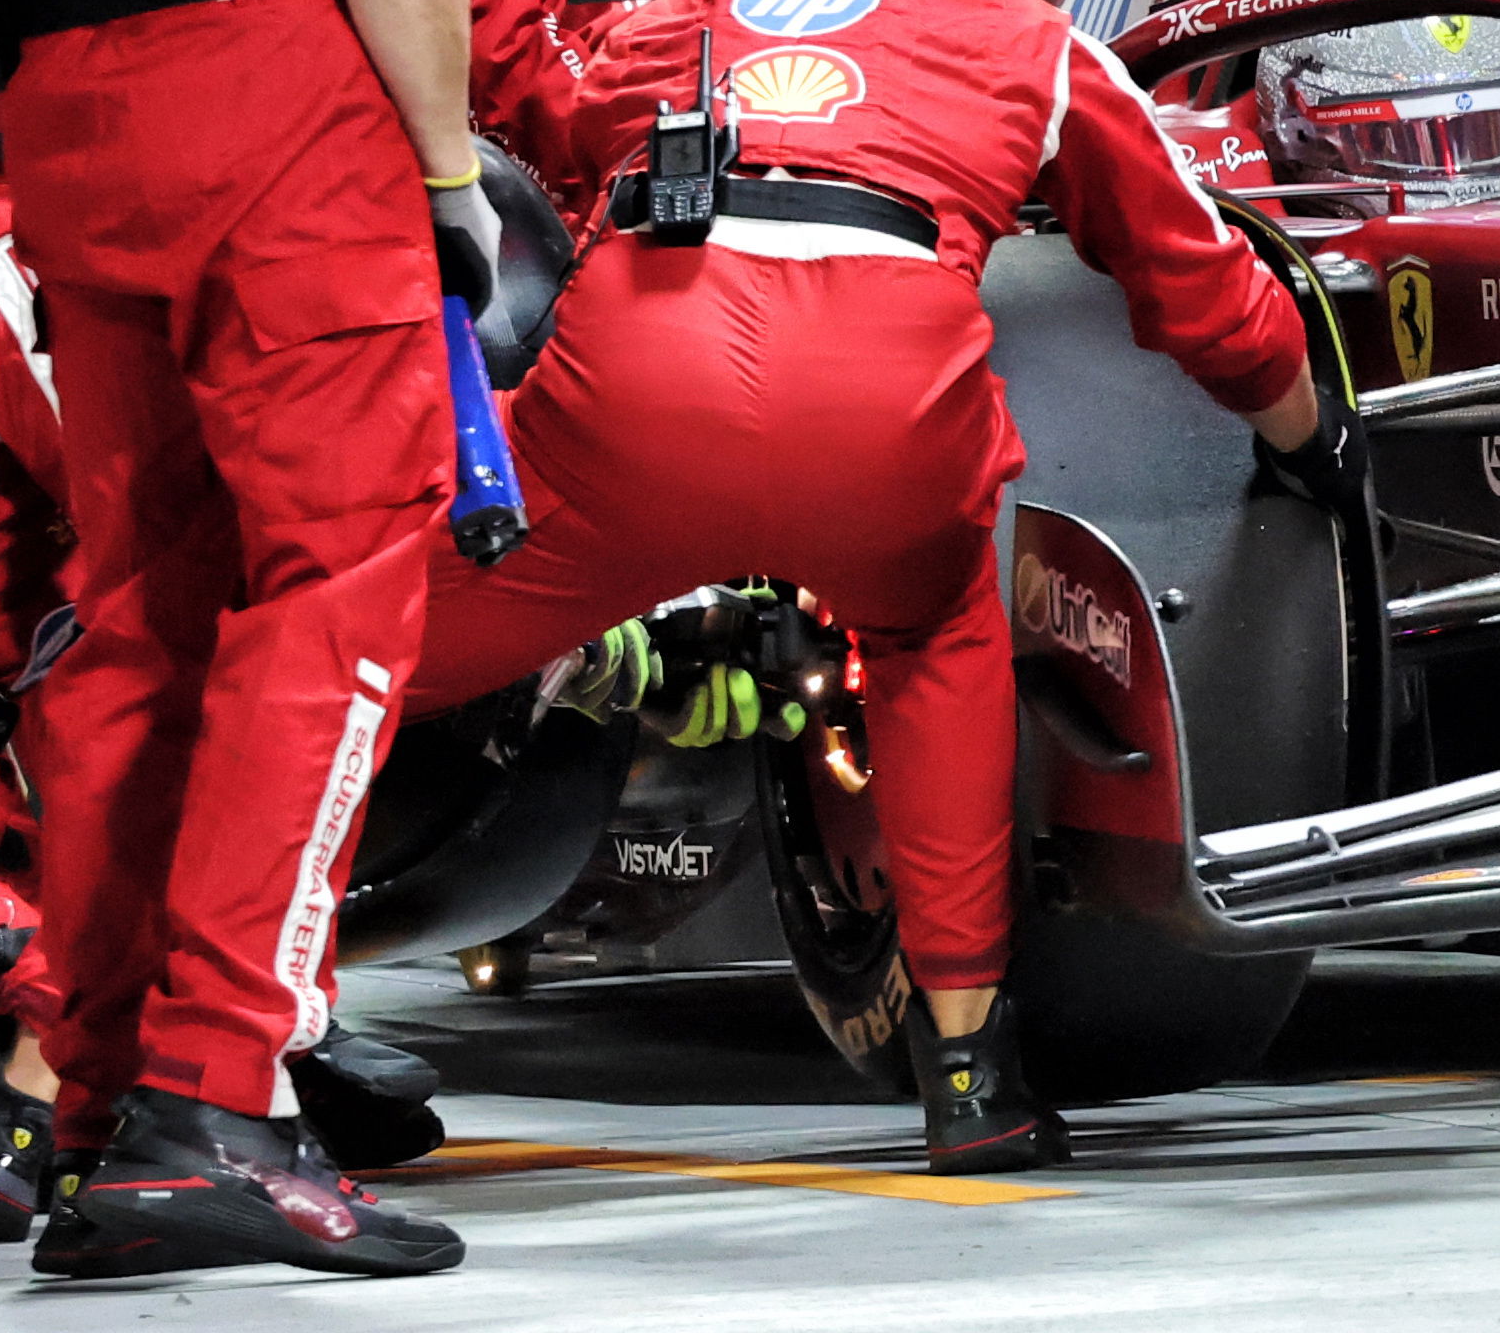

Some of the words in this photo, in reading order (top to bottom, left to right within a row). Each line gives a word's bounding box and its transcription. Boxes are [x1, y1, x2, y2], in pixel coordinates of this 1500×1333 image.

[1157, 0, 1221, 46] DXC
[1353, 106, 1381, 117] MILLE
[304, 725, 370, 896] SCUDERIA
[613, 829, 714, 877] VISTAJET
